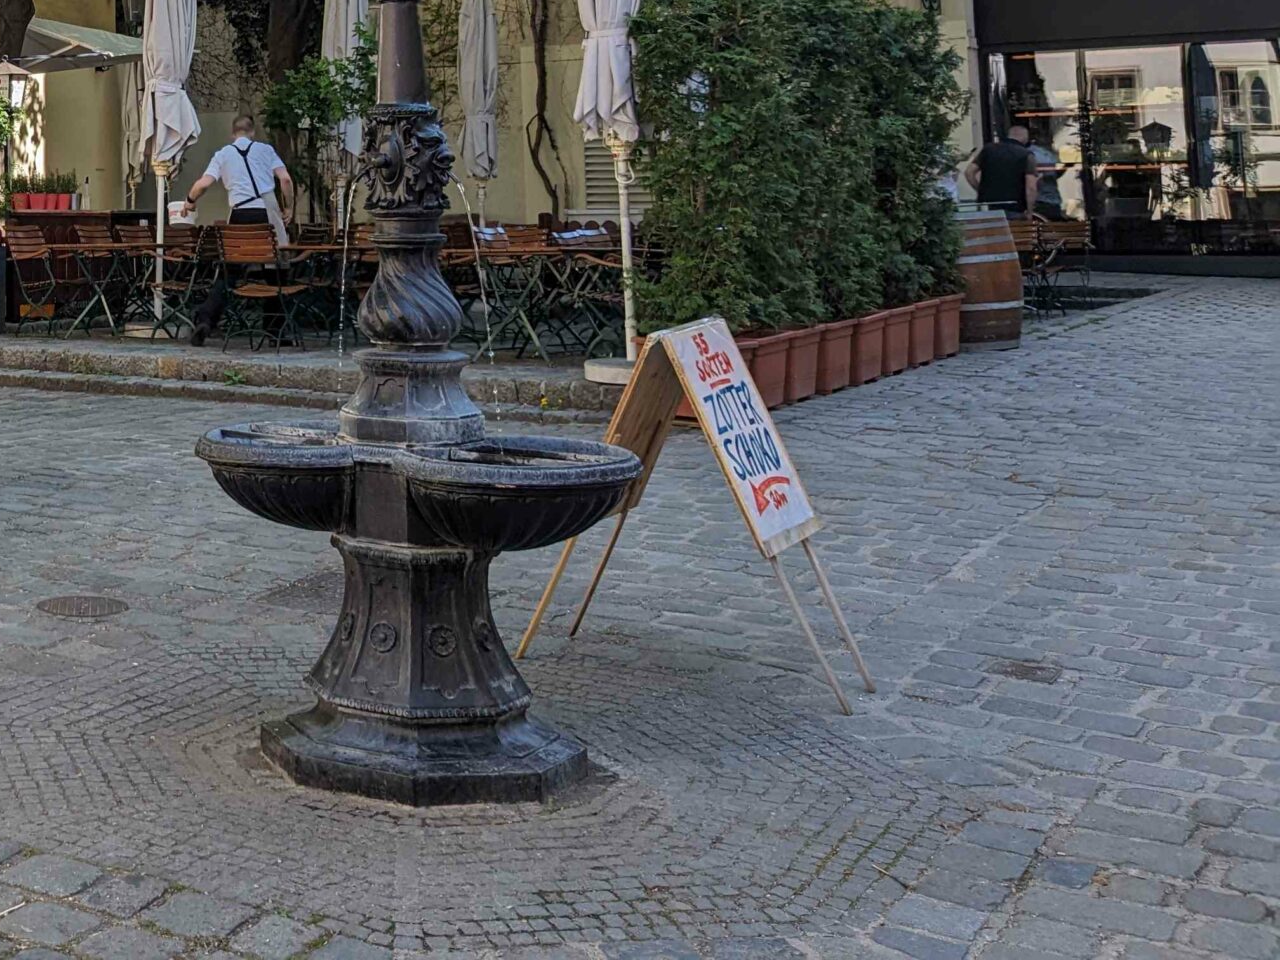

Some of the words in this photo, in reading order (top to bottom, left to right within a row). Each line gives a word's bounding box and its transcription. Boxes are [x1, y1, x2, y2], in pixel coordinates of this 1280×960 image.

[691, 332, 710, 356] 55
[695, 351, 734, 382] SORTEN
[703, 380, 763, 435] ZOTTER
[723, 427, 781, 481] SCHOKO
